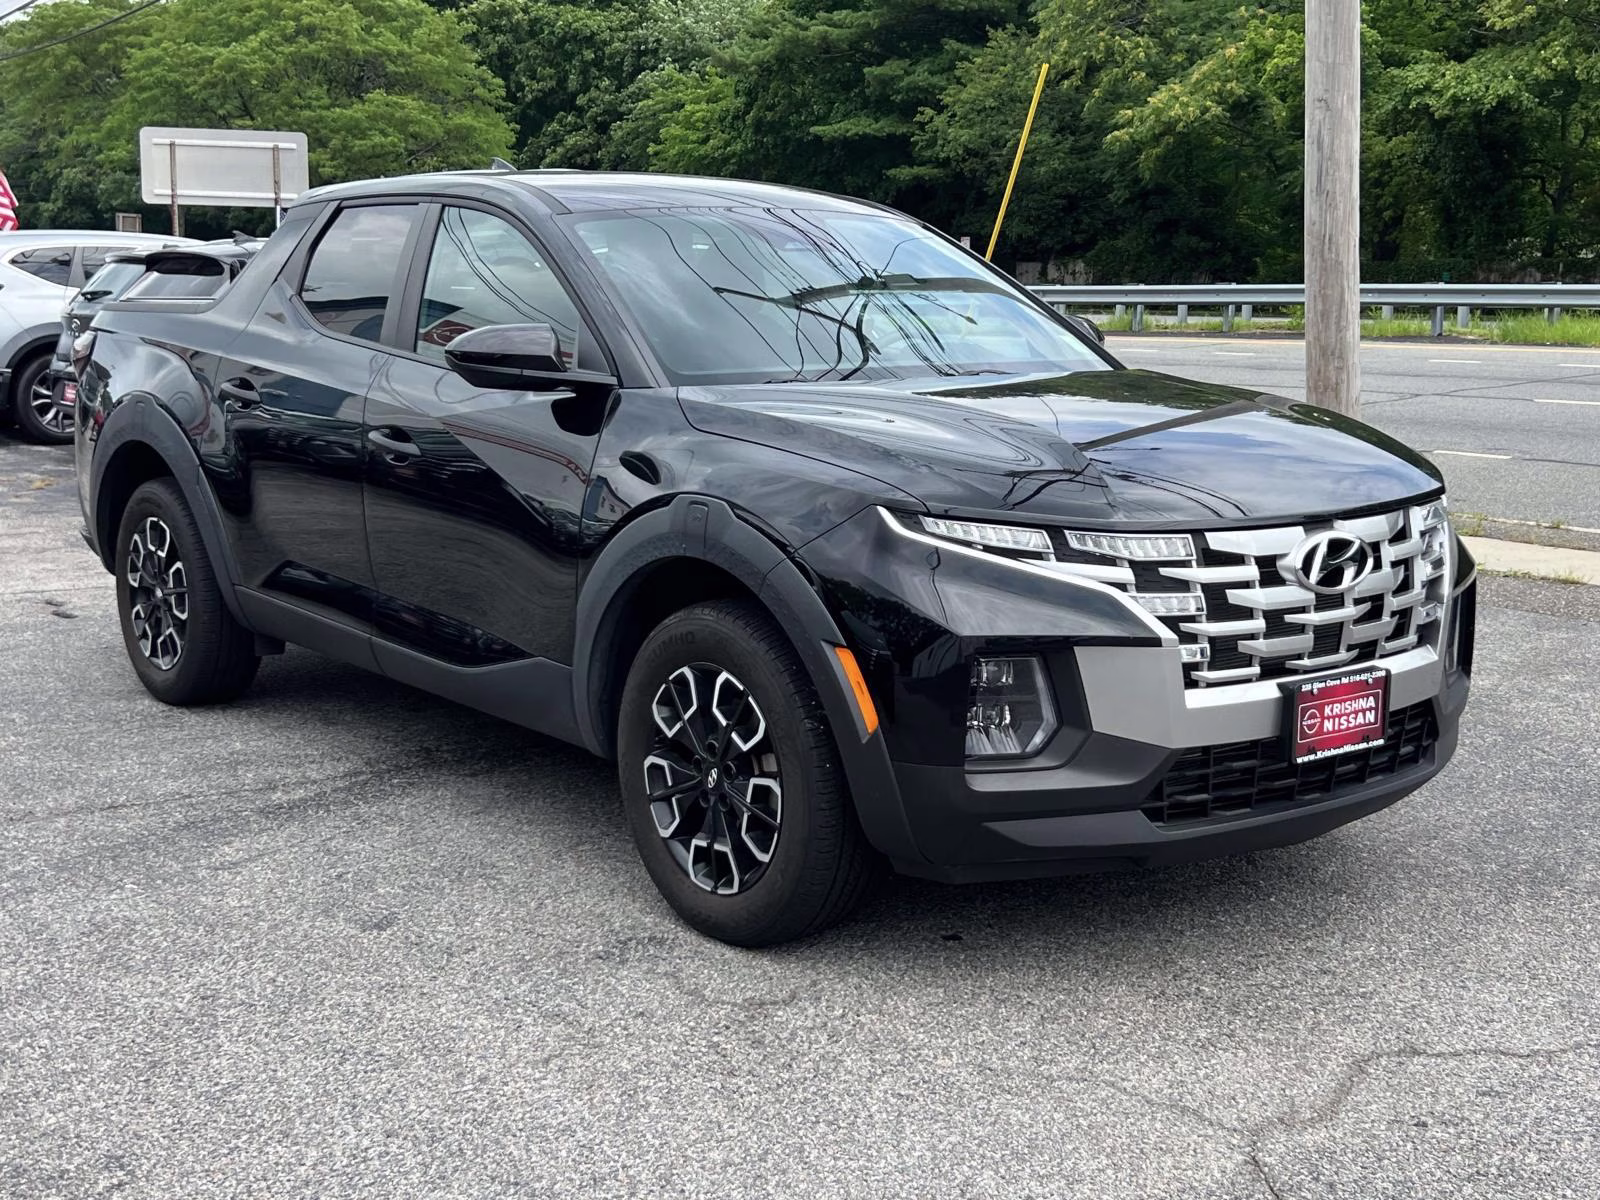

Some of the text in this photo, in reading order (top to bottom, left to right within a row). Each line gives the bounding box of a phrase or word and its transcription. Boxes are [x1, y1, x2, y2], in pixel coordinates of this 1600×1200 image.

[1313, 681, 1326, 689] Glen
[1326, 679, 1340, 687] Cove
[1341, 676, 1349, 684] Rd
[1324, 696, 1376, 717] KRISHNA
[1323, 710, 1375, 732] NISSAN
[1296, 738, 1385, 763] www.KrishnaNissan.com
